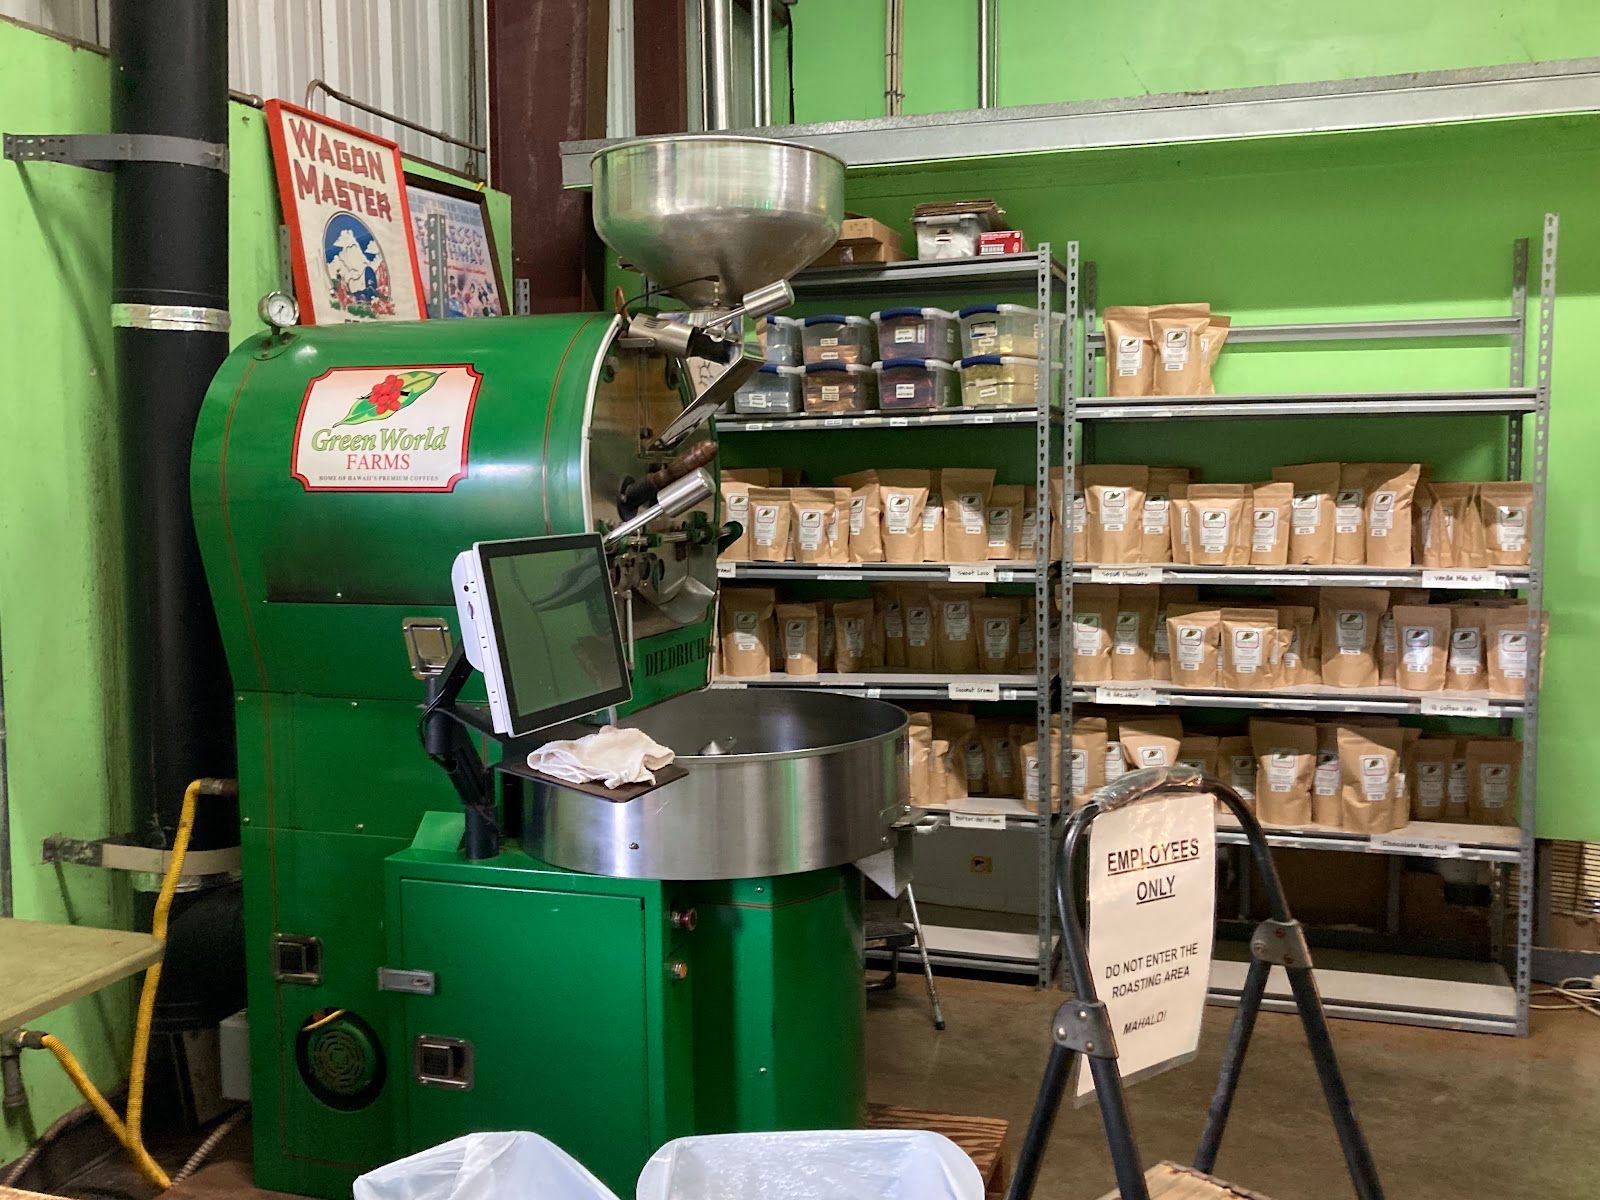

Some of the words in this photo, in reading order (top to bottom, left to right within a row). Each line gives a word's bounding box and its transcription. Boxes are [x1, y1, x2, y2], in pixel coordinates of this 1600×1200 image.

[288, 118, 386, 184] WAGON
[293, 158, 393, 222] MASTER
[346, 454, 410, 470] FARMS
[1107, 838, 1199, 873] EMPLOYEES
[1136, 875, 1176, 901] ONLY
[1105, 963, 1121, 979] DO
[1122, 957, 1144, 975] NOT
[1145, 948, 1178, 968] ENTER
[1180, 942, 1198, 959] THE
[1111, 973, 1162, 999] ROASTING
[1164, 965, 1190, 984] AREA
[1122, 1009, 1168, 1035] MAHALO!
